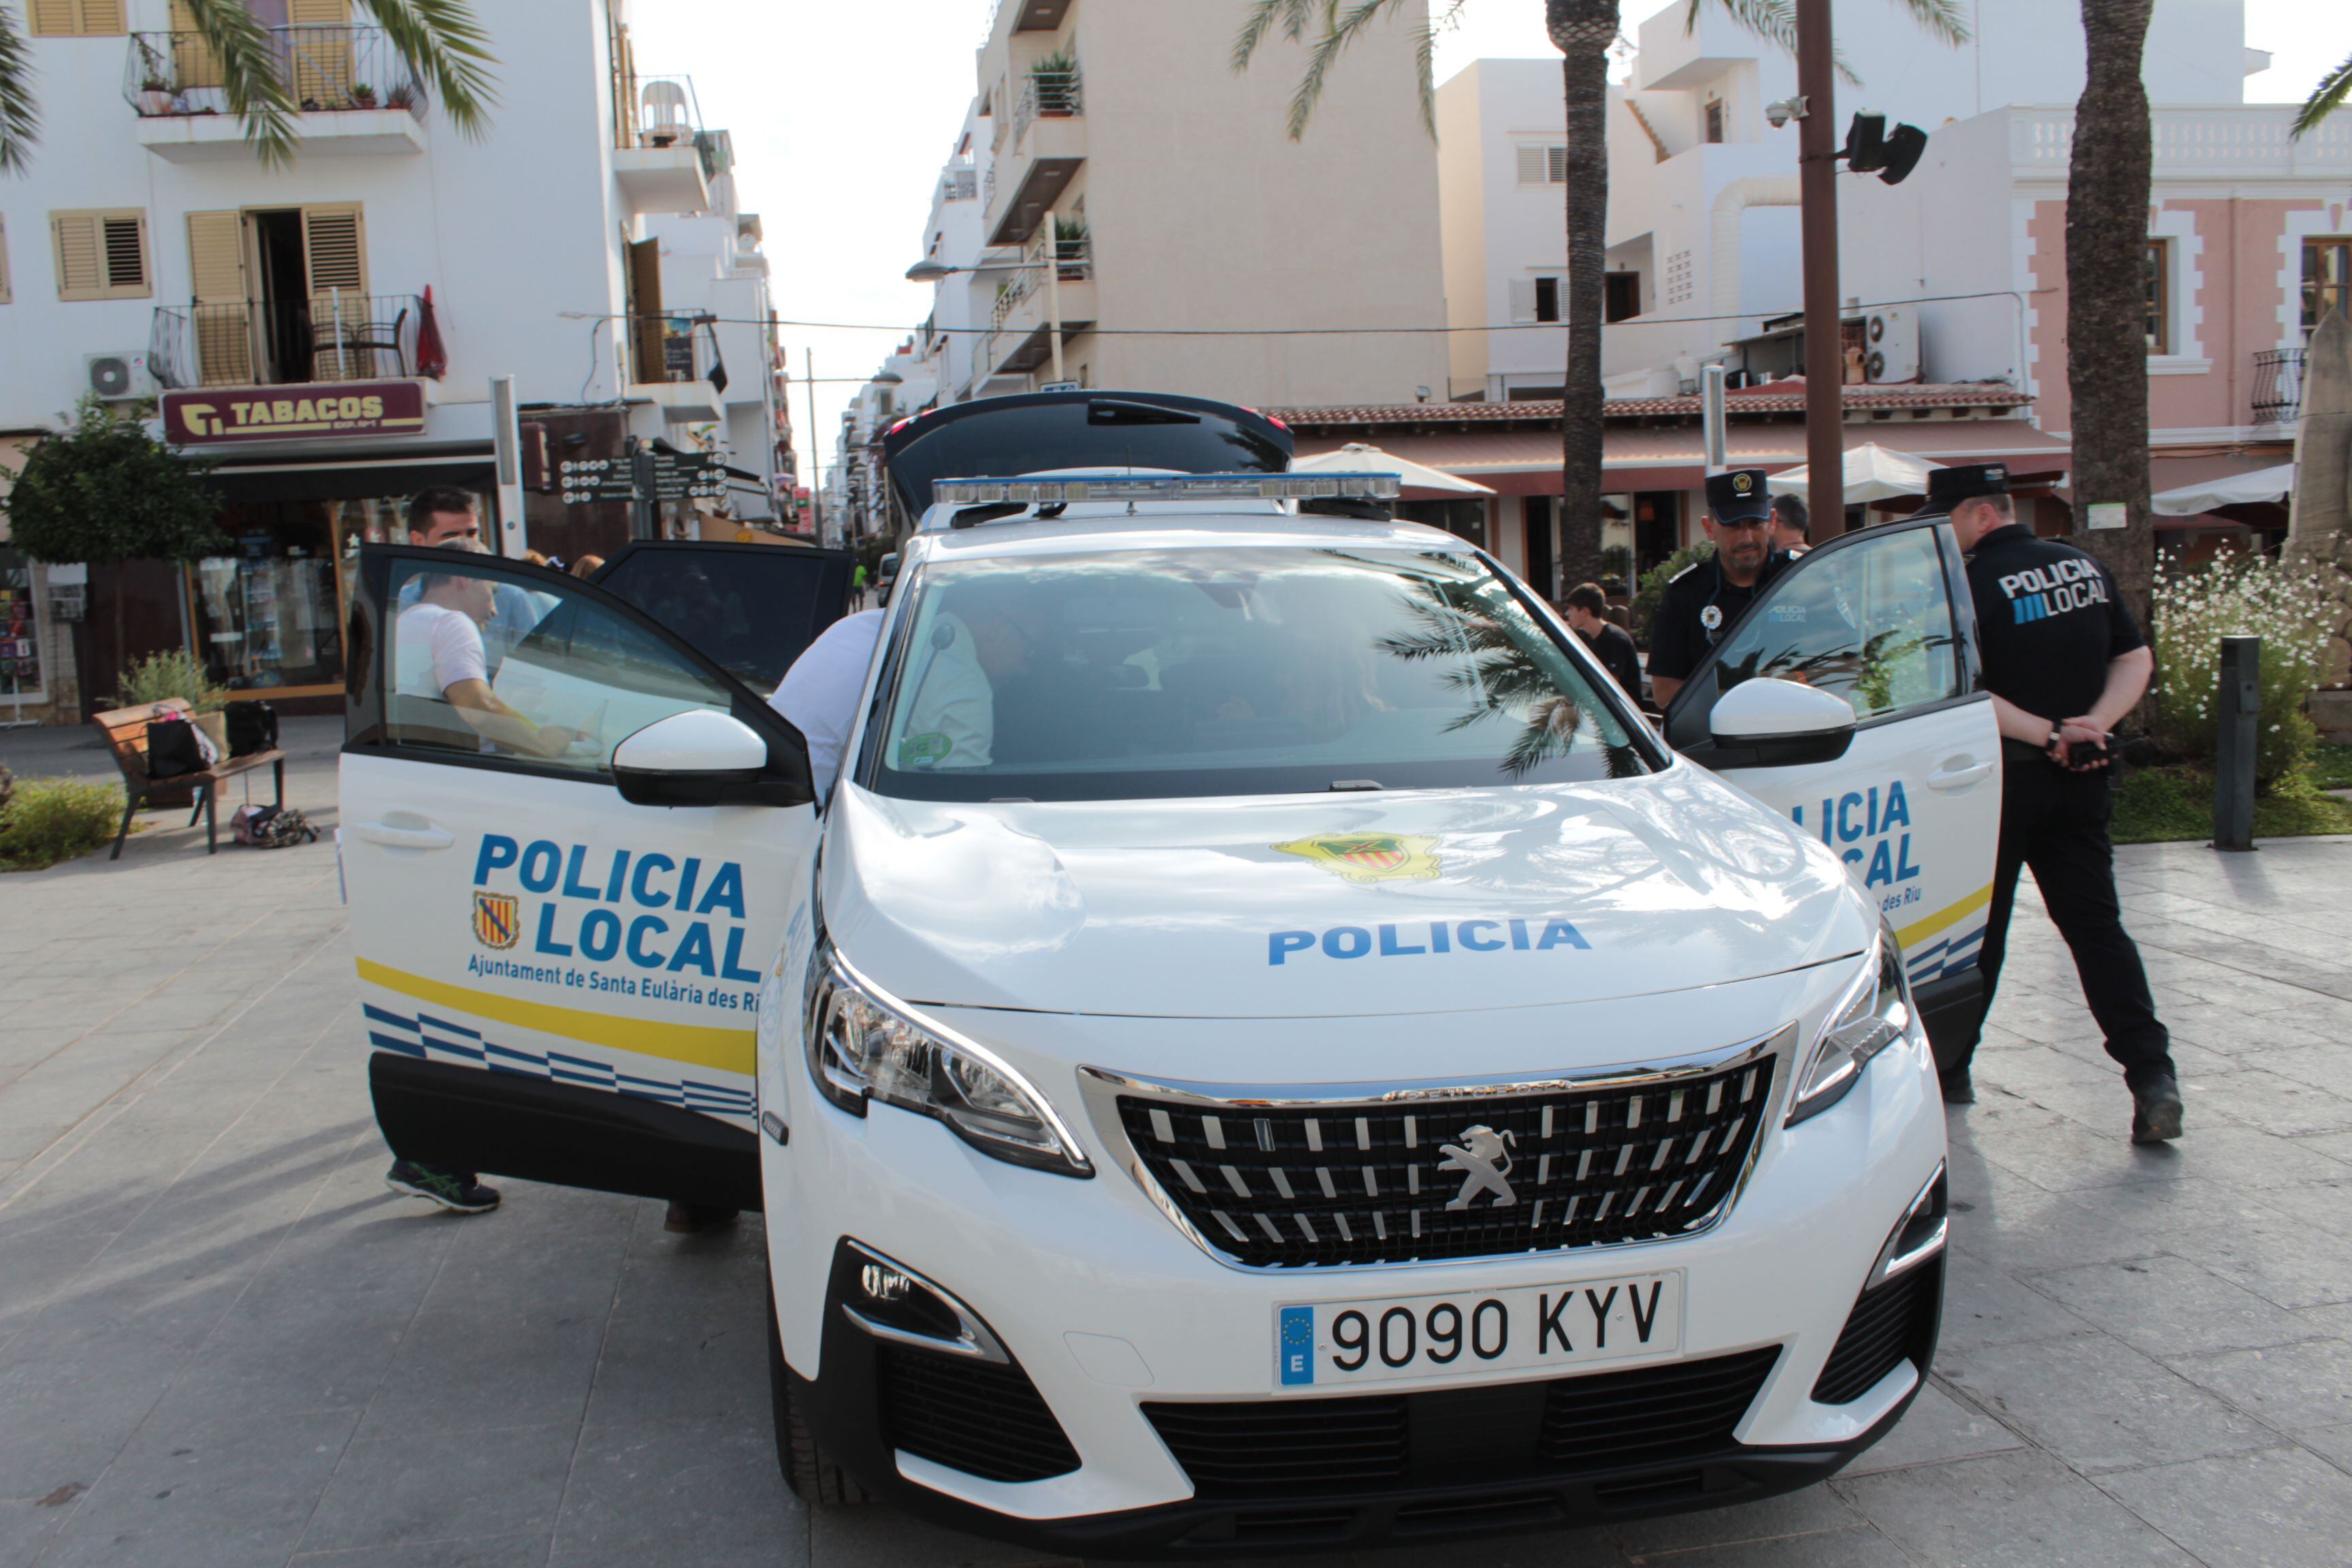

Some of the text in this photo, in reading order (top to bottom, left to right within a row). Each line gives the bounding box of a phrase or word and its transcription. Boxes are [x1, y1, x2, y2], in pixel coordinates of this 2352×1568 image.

[230, 395, 383, 425] TABACOS
[1998, 559, 2102, 599] POLICIA
[2042, 579, 2109, 617] LOCAL
[1780, 613, 1807, 622] LOCAL
[474, 834, 746, 919] POLICIA
[1882, 885, 1922, 912] des Riu
[535, 902, 762, 984] LOCAL
[1269, 919, 1592, 966] POLICIA
[468, 954, 761, 1013] Ajuntament de Santa Eulària des Ri
[1402, 1081, 1552, 1100] PEUGEOT
[1332, 1280, 1663, 1372] 9090 KYV
[1291, 1354, 1303, 1373] E
